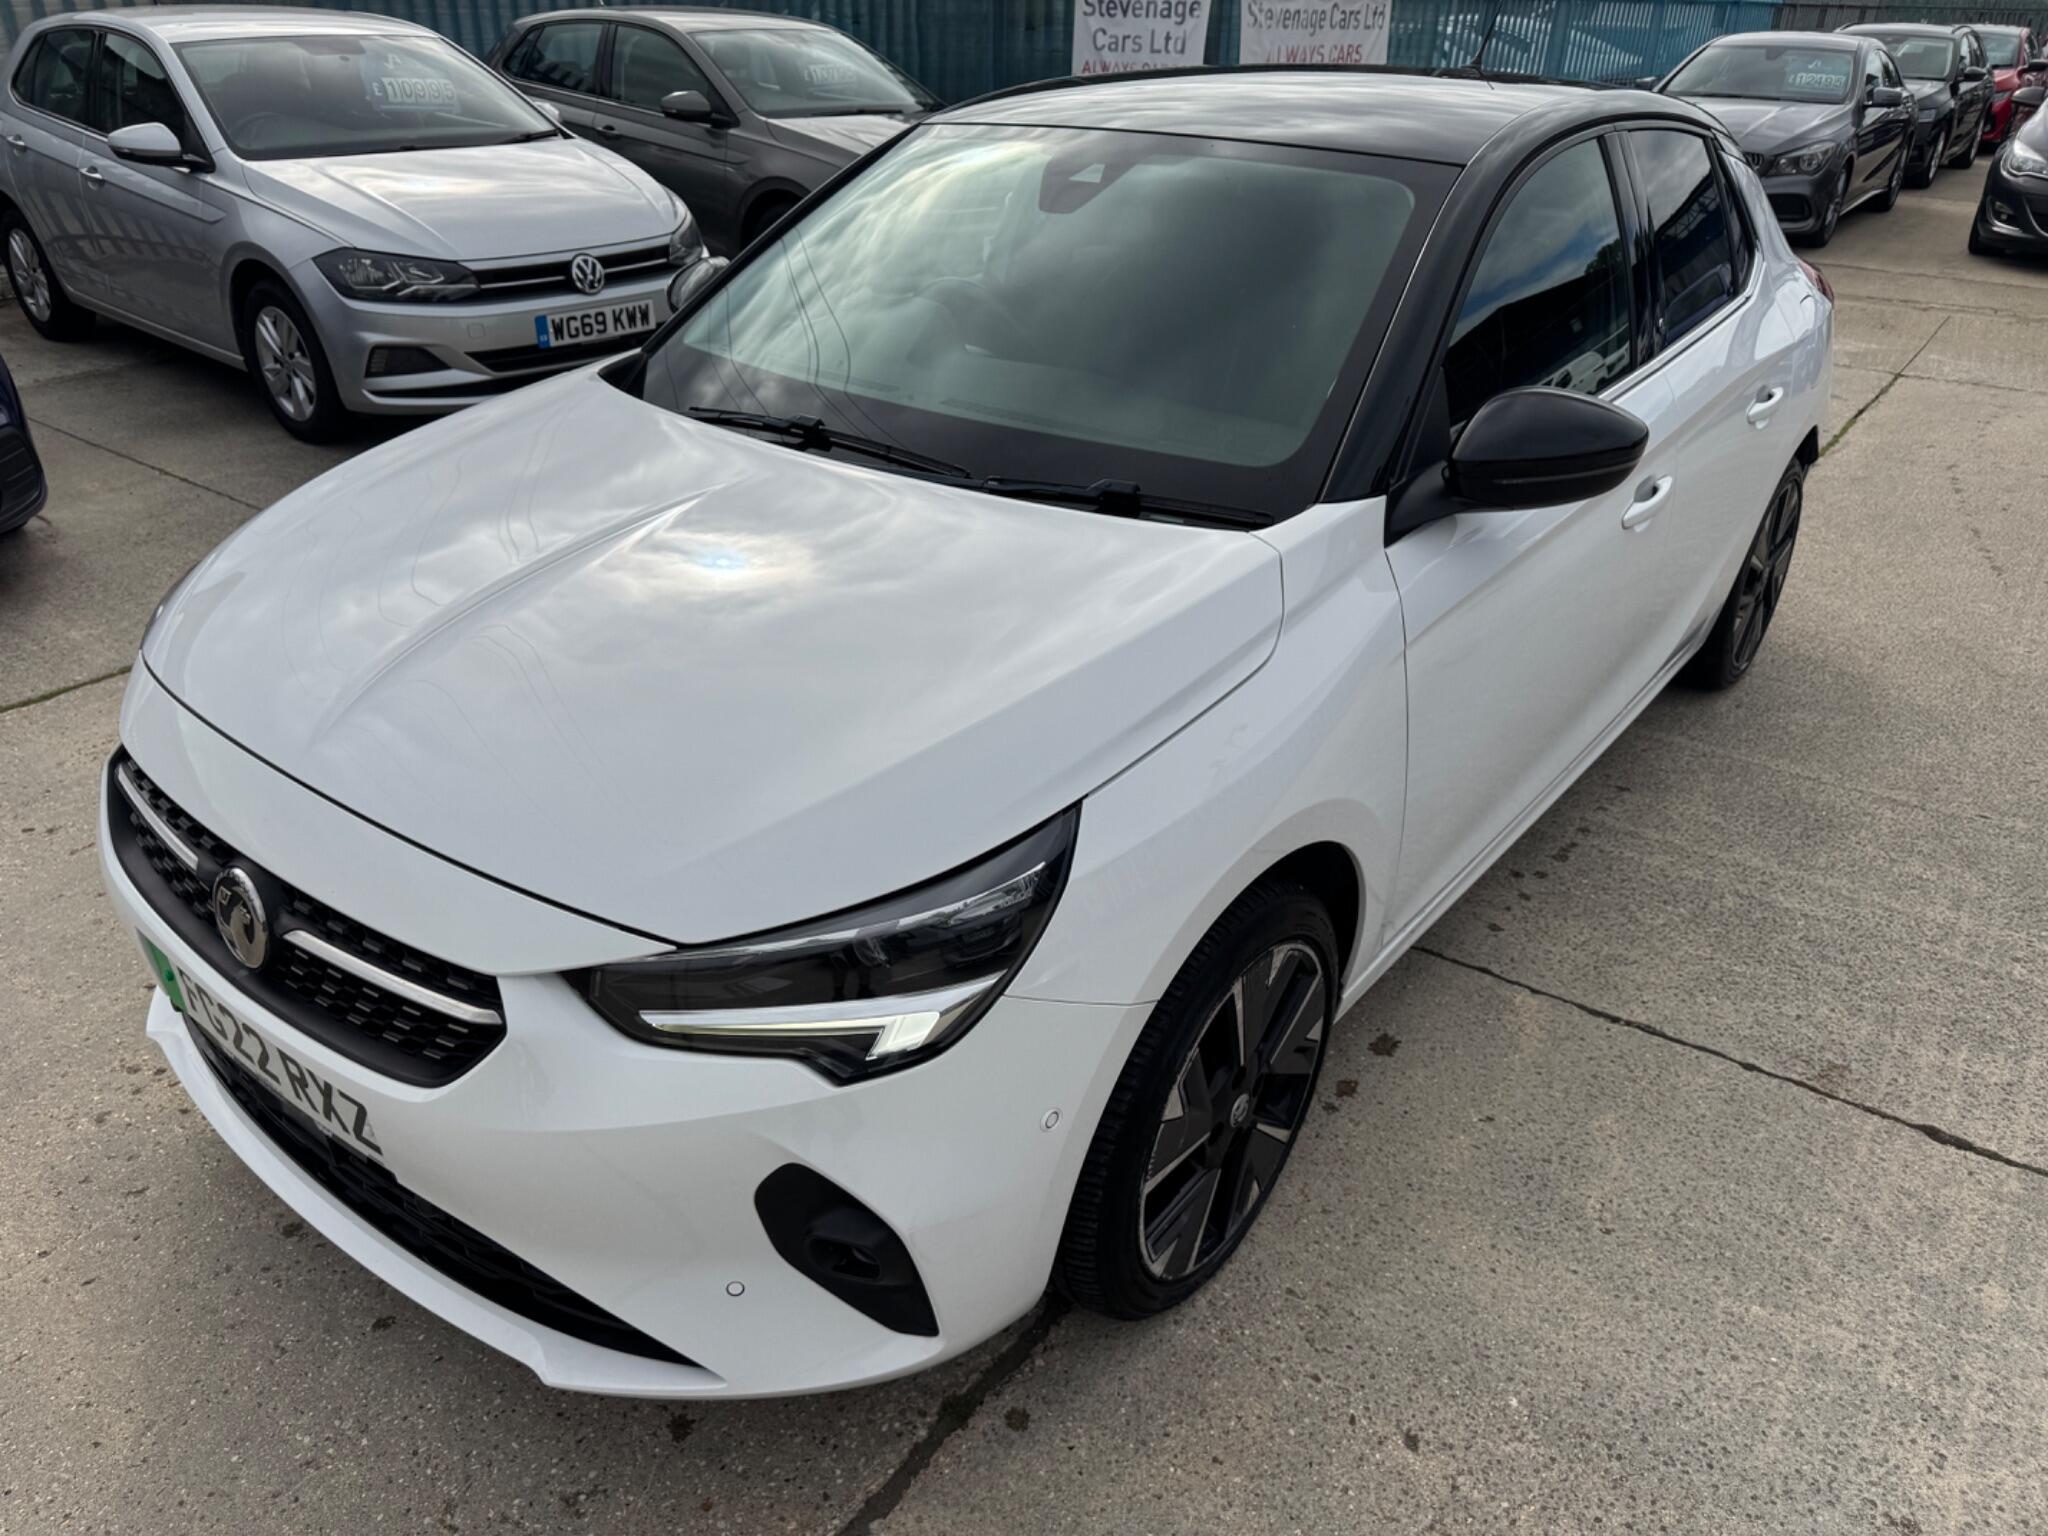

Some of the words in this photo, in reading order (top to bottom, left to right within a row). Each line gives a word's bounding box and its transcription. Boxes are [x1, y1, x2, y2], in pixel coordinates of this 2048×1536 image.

[1083, 0, 1201, 25] Stevenage
[1248, 0, 1327, 37] Stevenage
[1329, 2, 1361, 30] Cars
[1364, 3, 1386, 30] Ltd
[1093, 28, 1142, 53] Cars
[1150, 29, 1187, 54] Ltd
[1329, 44, 1362, 63] CARS
[552, 312, 607, 341] WG69
[612, 303, 650, 332] KWW
[277, 1047, 383, 1157] RXZ
